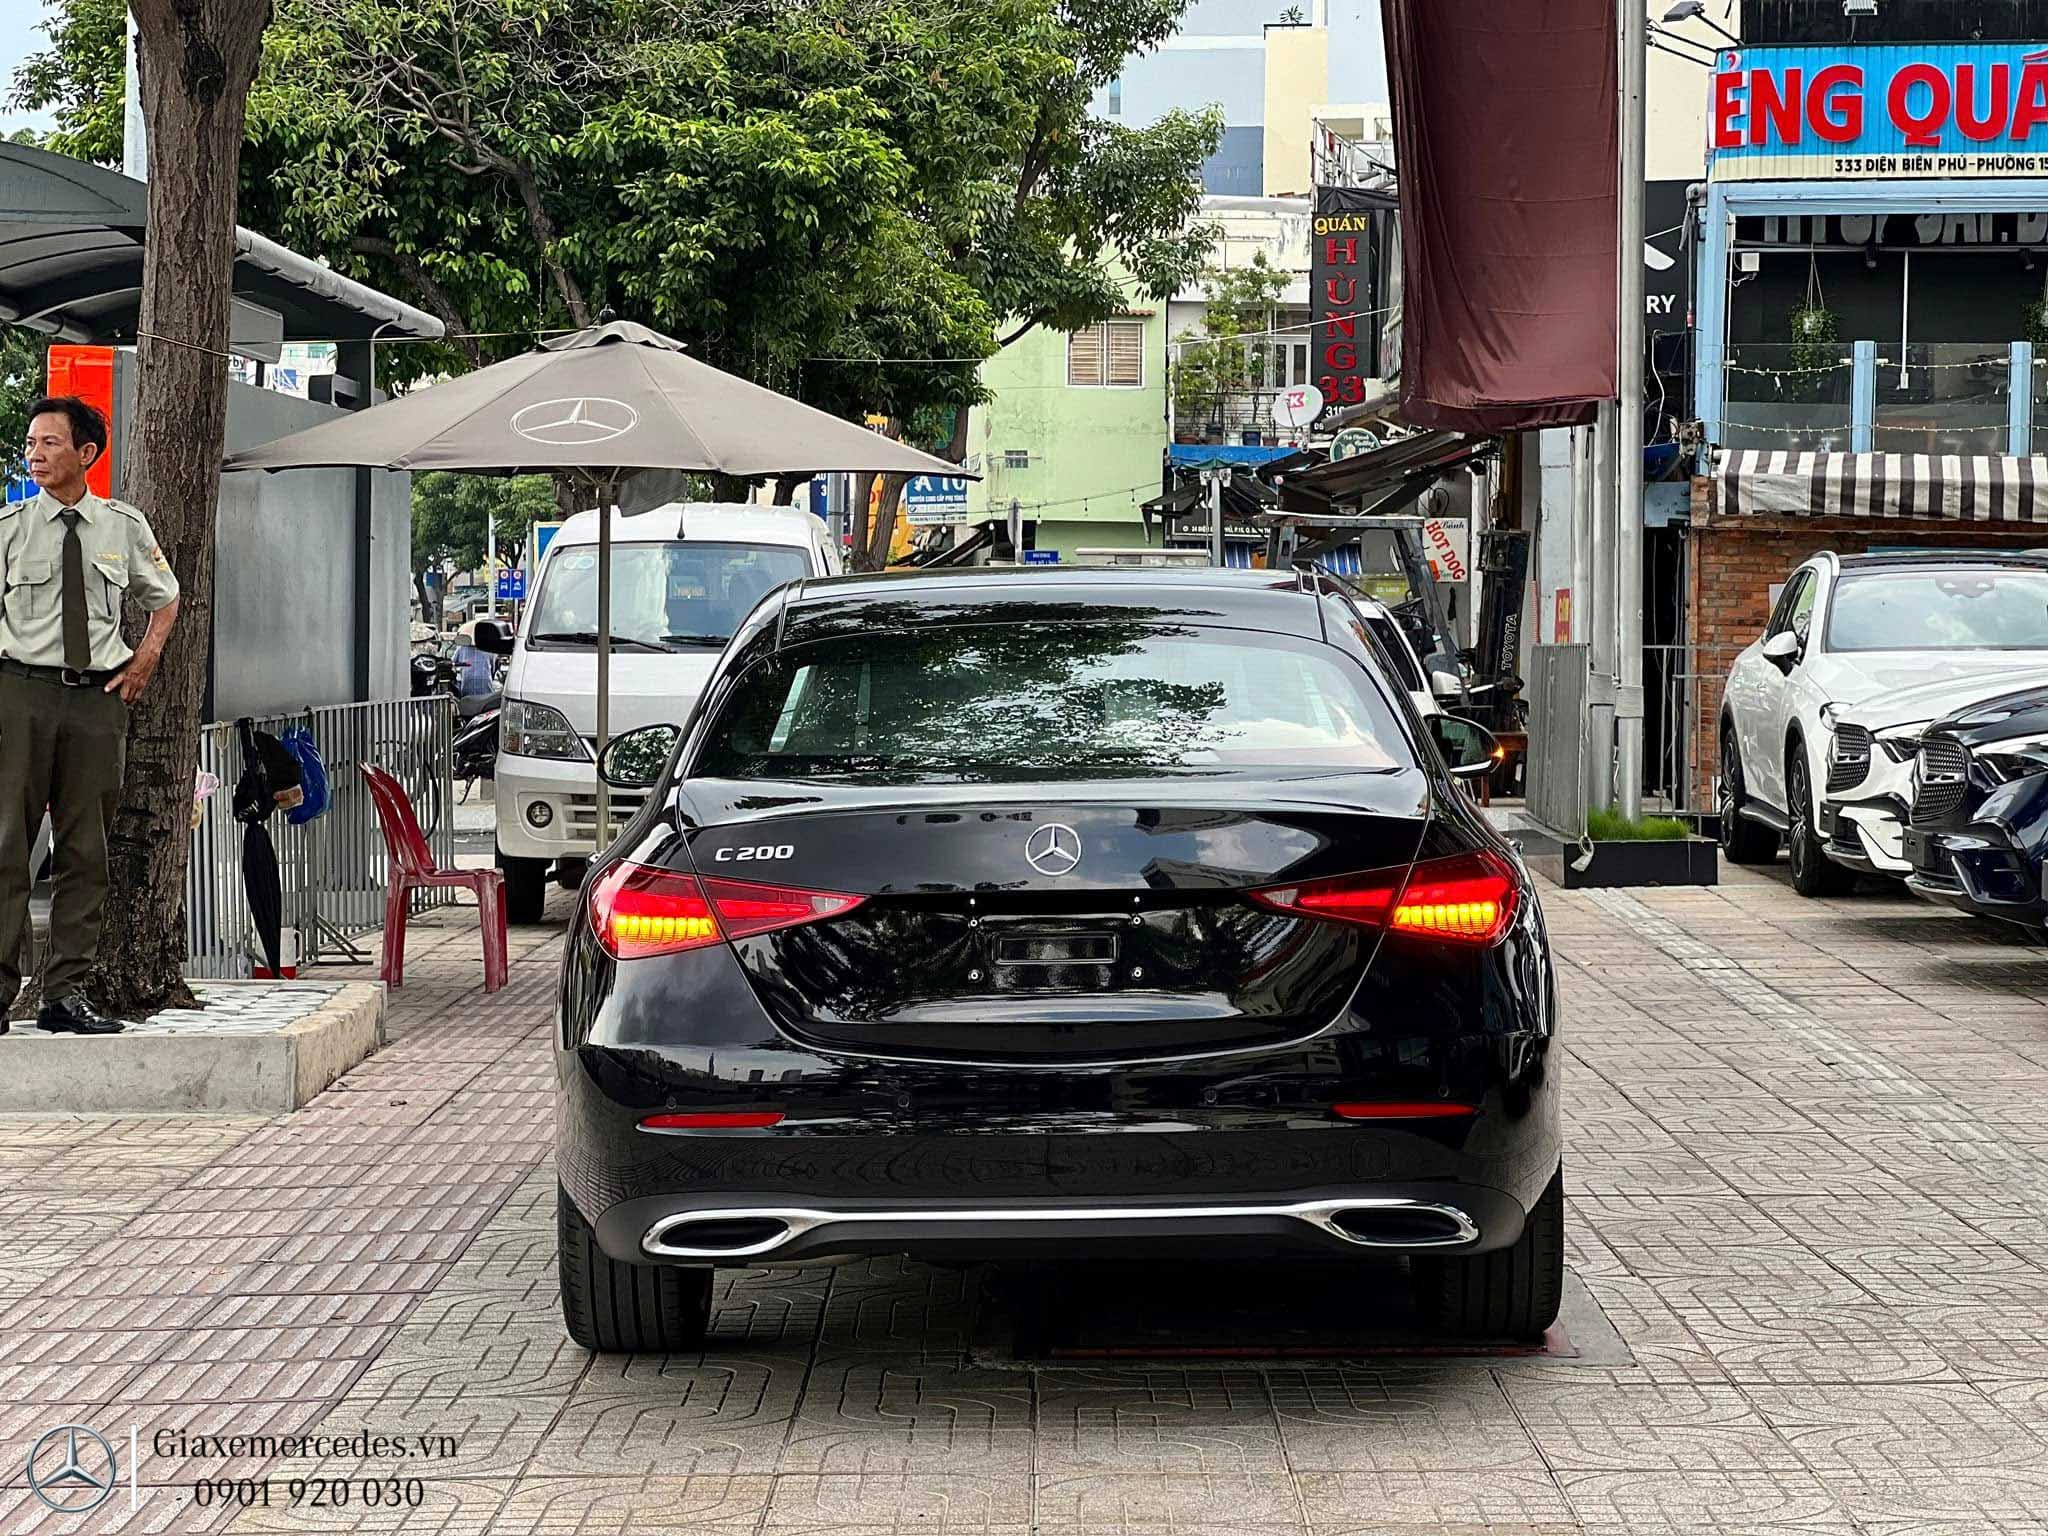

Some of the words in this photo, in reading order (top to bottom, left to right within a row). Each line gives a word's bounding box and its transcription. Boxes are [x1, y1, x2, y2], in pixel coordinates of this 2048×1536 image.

[1835, 159, 1862, 172] 333
[1314, 213, 1366, 235] QUÁN
[1324, 238, 1358, 371] HÙNG
[1320, 375, 1365, 404] 33
[1426, 521, 1450, 549] HOT
[1441, 550, 1466, 580] DOG
[1501, 613, 1518, 670] TOYOTA
[715, 848, 734, 861] C
[736, 845, 795, 861] 200
